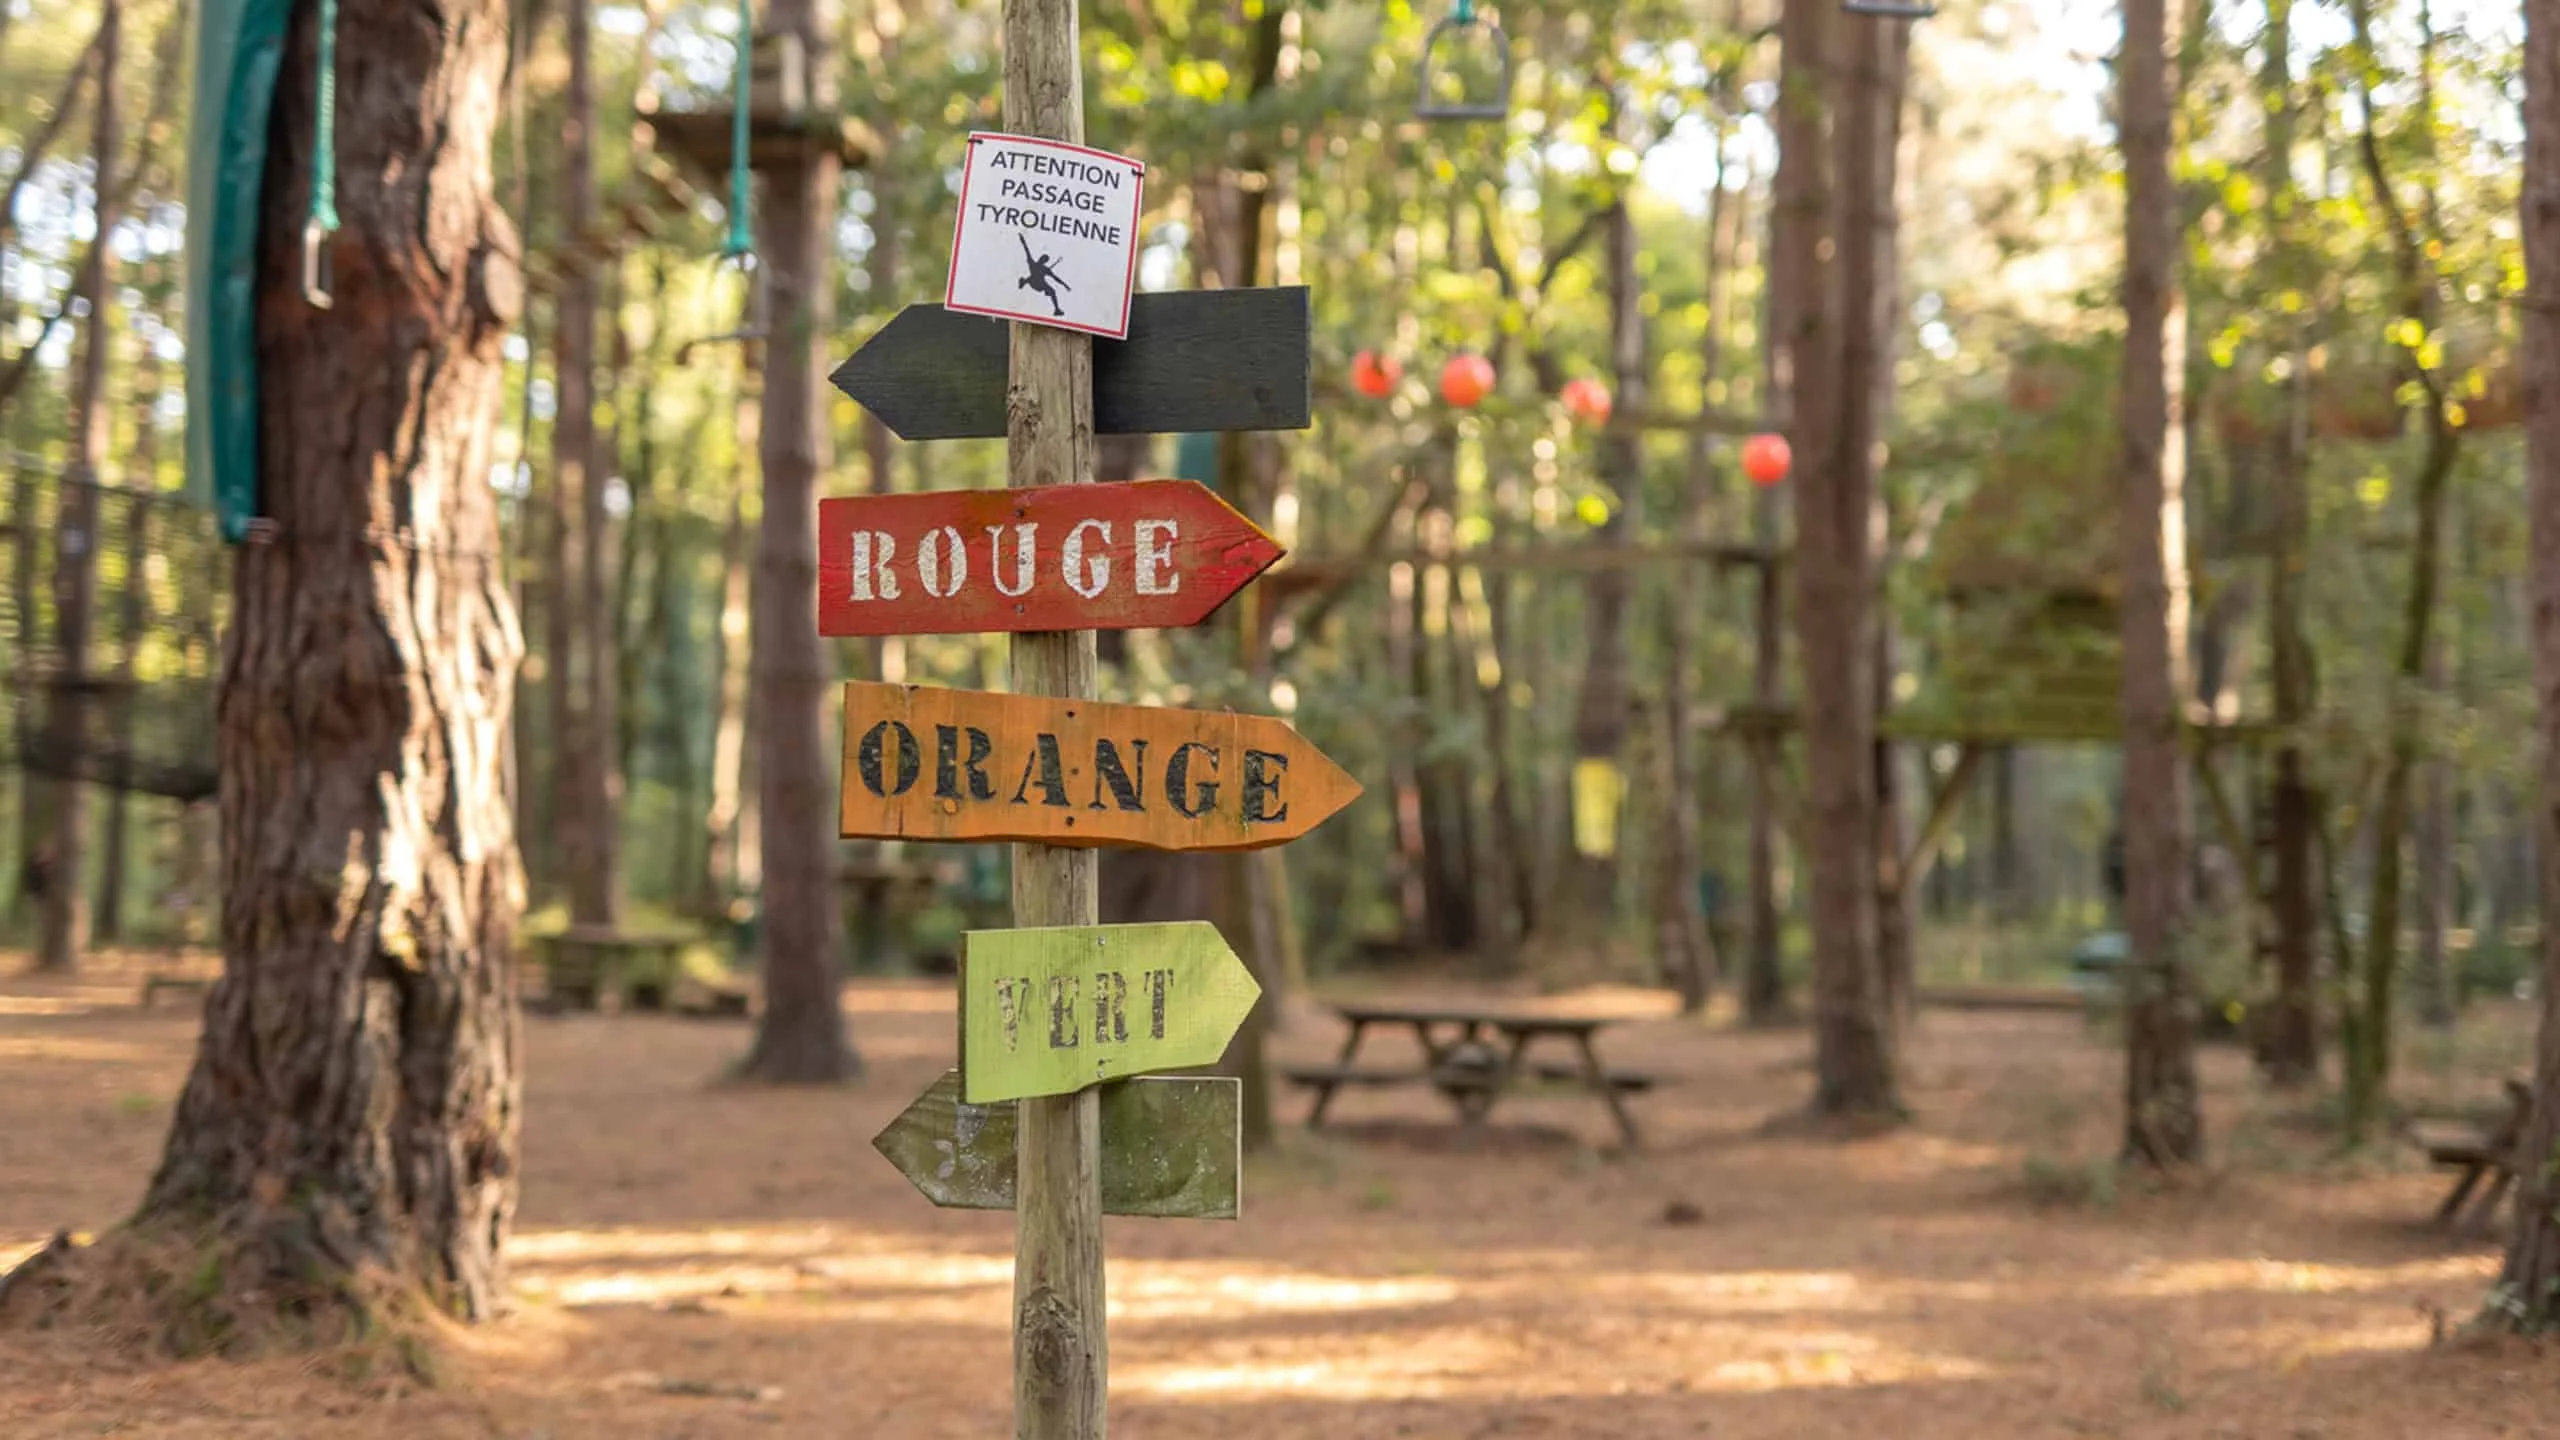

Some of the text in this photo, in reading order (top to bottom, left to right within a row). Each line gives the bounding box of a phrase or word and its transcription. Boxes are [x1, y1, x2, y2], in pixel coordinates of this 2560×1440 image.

[990, 151, 1121, 189] ATTENTION
[1001, 179, 1105, 214] PASSAGE
[977, 203, 1121, 246] TYROLIENNE
[849, 518, 1179, 600] ROUGE
[858, 719, 1289, 824] ORANGE
[993, 968, 1174, 1052] VERT
